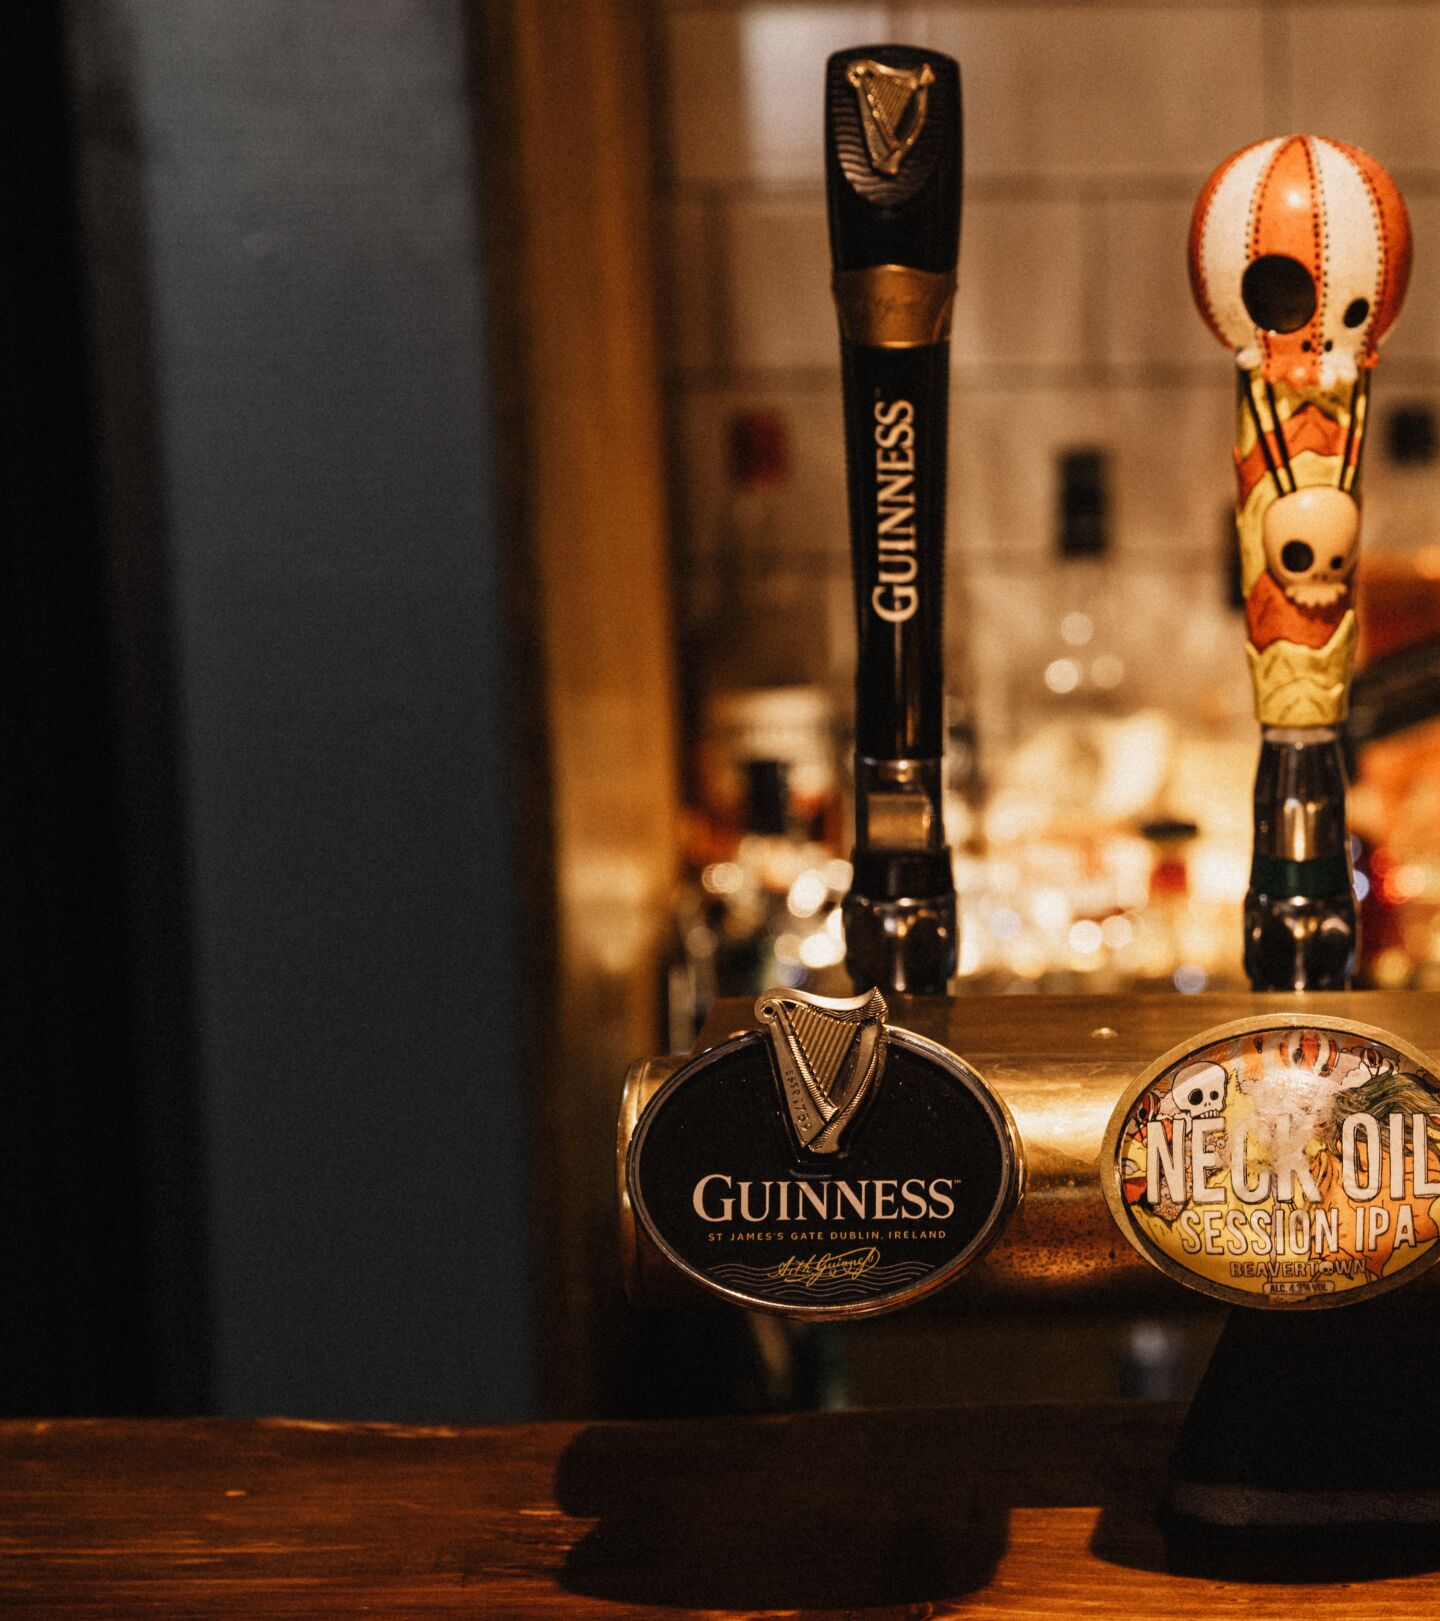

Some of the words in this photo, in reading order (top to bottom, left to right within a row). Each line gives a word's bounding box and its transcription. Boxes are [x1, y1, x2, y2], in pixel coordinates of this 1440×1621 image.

[872, 400, 919, 623] GUINNESS
[1146, 1113, 1323, 1205] NECK
[692, 1174, 956, 1223] GUINNESS
[708, 1233, 723, 1242] ST
[730, 1232, 785, 1241] JAMES'S
[790, 1231, 825, 1241] GATE
[888, 1230, 947, 1240] IRELAND
[1181, 1208, 1339, 1256] SESSION
[1355, 1207, 1417, 1254] IPA
[1229, 1258, 1367, 1278] BEAVERTOWN
